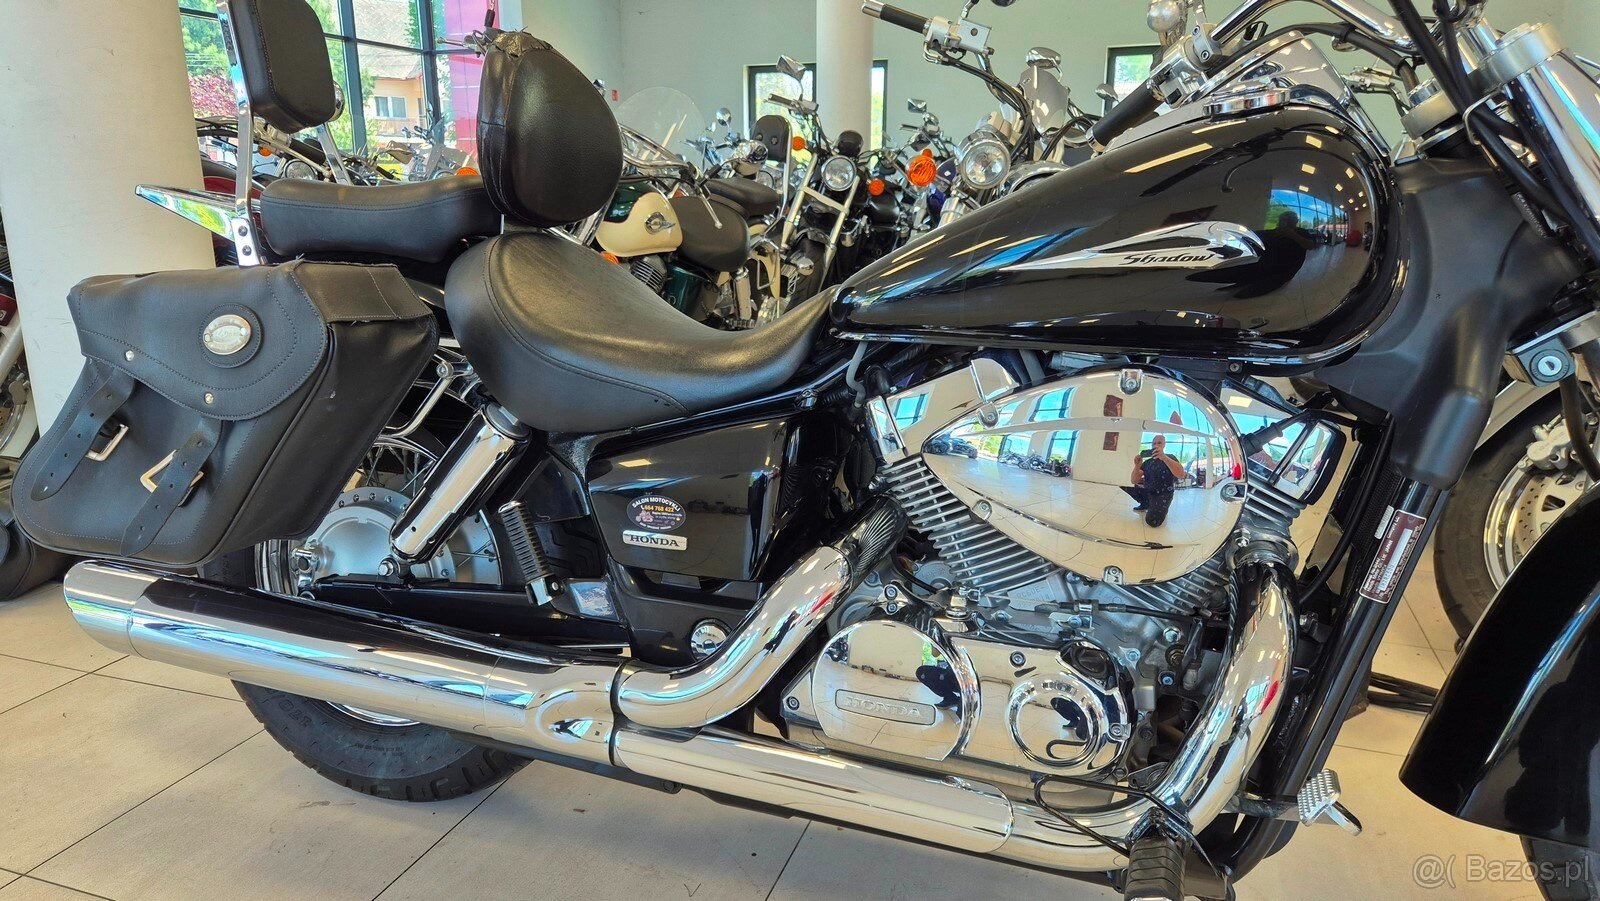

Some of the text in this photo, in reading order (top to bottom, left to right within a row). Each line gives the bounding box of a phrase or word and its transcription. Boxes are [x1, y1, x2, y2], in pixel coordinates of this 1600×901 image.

[1118, 253, 1215, 265] Shadow
[632, 497, 680, 511] SALON MOTOCYKLI
[629, 535, 679, 546] HONDA
[844, 696, 921, 718] HONDA
